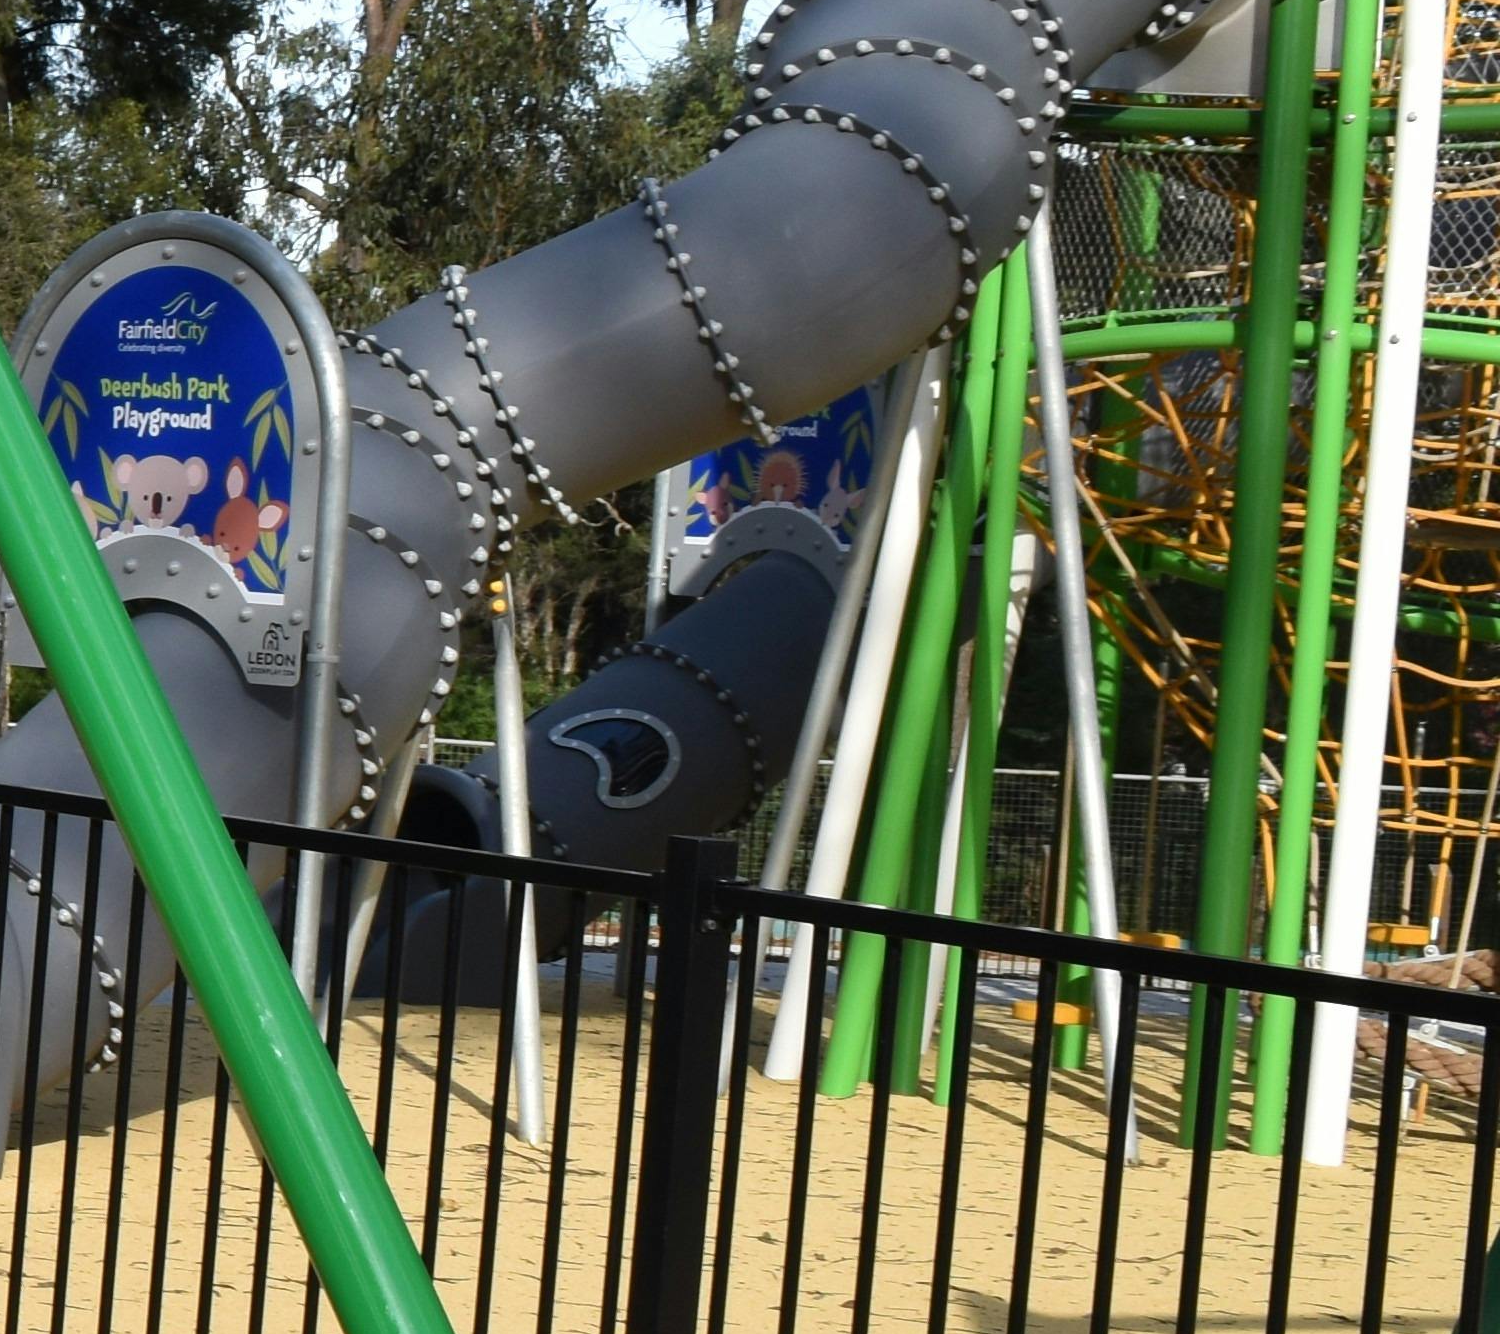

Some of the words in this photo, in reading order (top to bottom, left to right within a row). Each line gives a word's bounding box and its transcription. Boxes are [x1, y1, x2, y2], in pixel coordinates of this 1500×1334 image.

[118, 343, 156, 355] Celebrating
[157, 344, 186, 354] diversity
[100, 372, 182, 400] Deerbush
[187, 374, 231, 404] Park
[112, 401, 212, 437] Playground
[247, 651, 297, 667] LEDON
